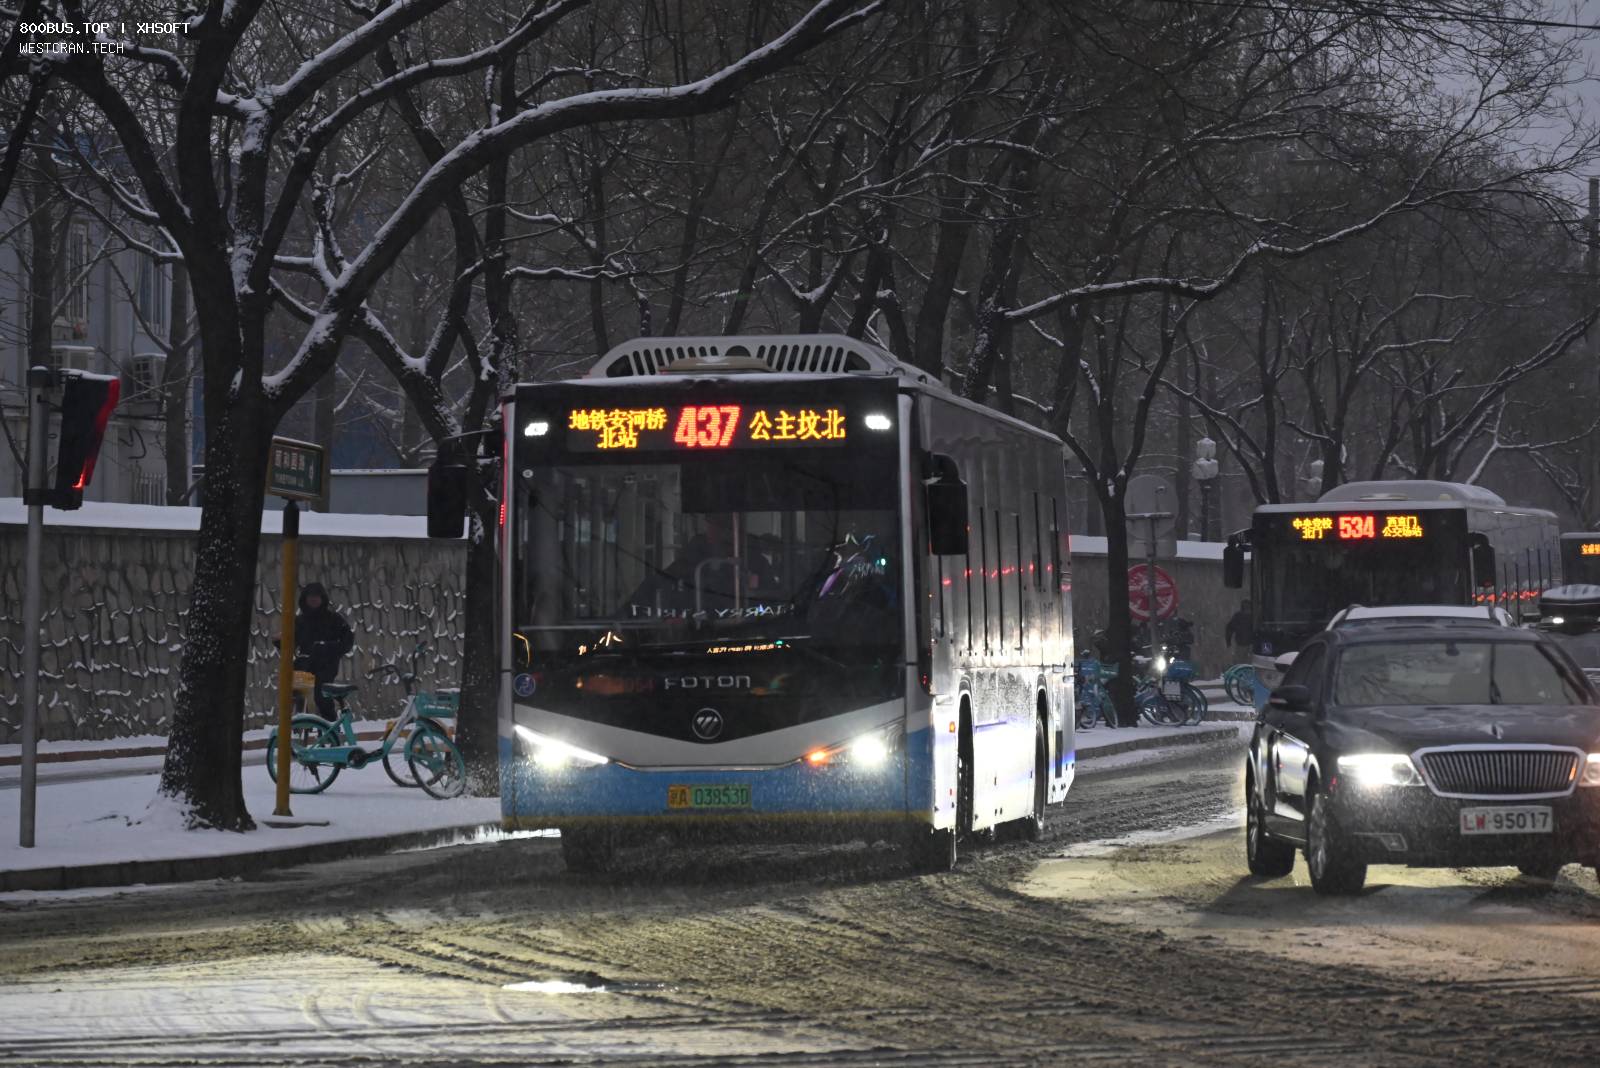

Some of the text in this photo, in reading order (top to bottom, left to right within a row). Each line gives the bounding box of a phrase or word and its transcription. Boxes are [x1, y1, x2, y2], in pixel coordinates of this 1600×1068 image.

[568, 408, 668, 430] 地铁安河桥
[674, 406, 741, 448] 437
[749, 409, 847, 440] 公主坟北
[597, 425, 638, 449] 北站
[1339, 516, 1375, 538] 534
[664, 675, 751, 690] FOTON
[1493, 812, 1549, 829] 95017
